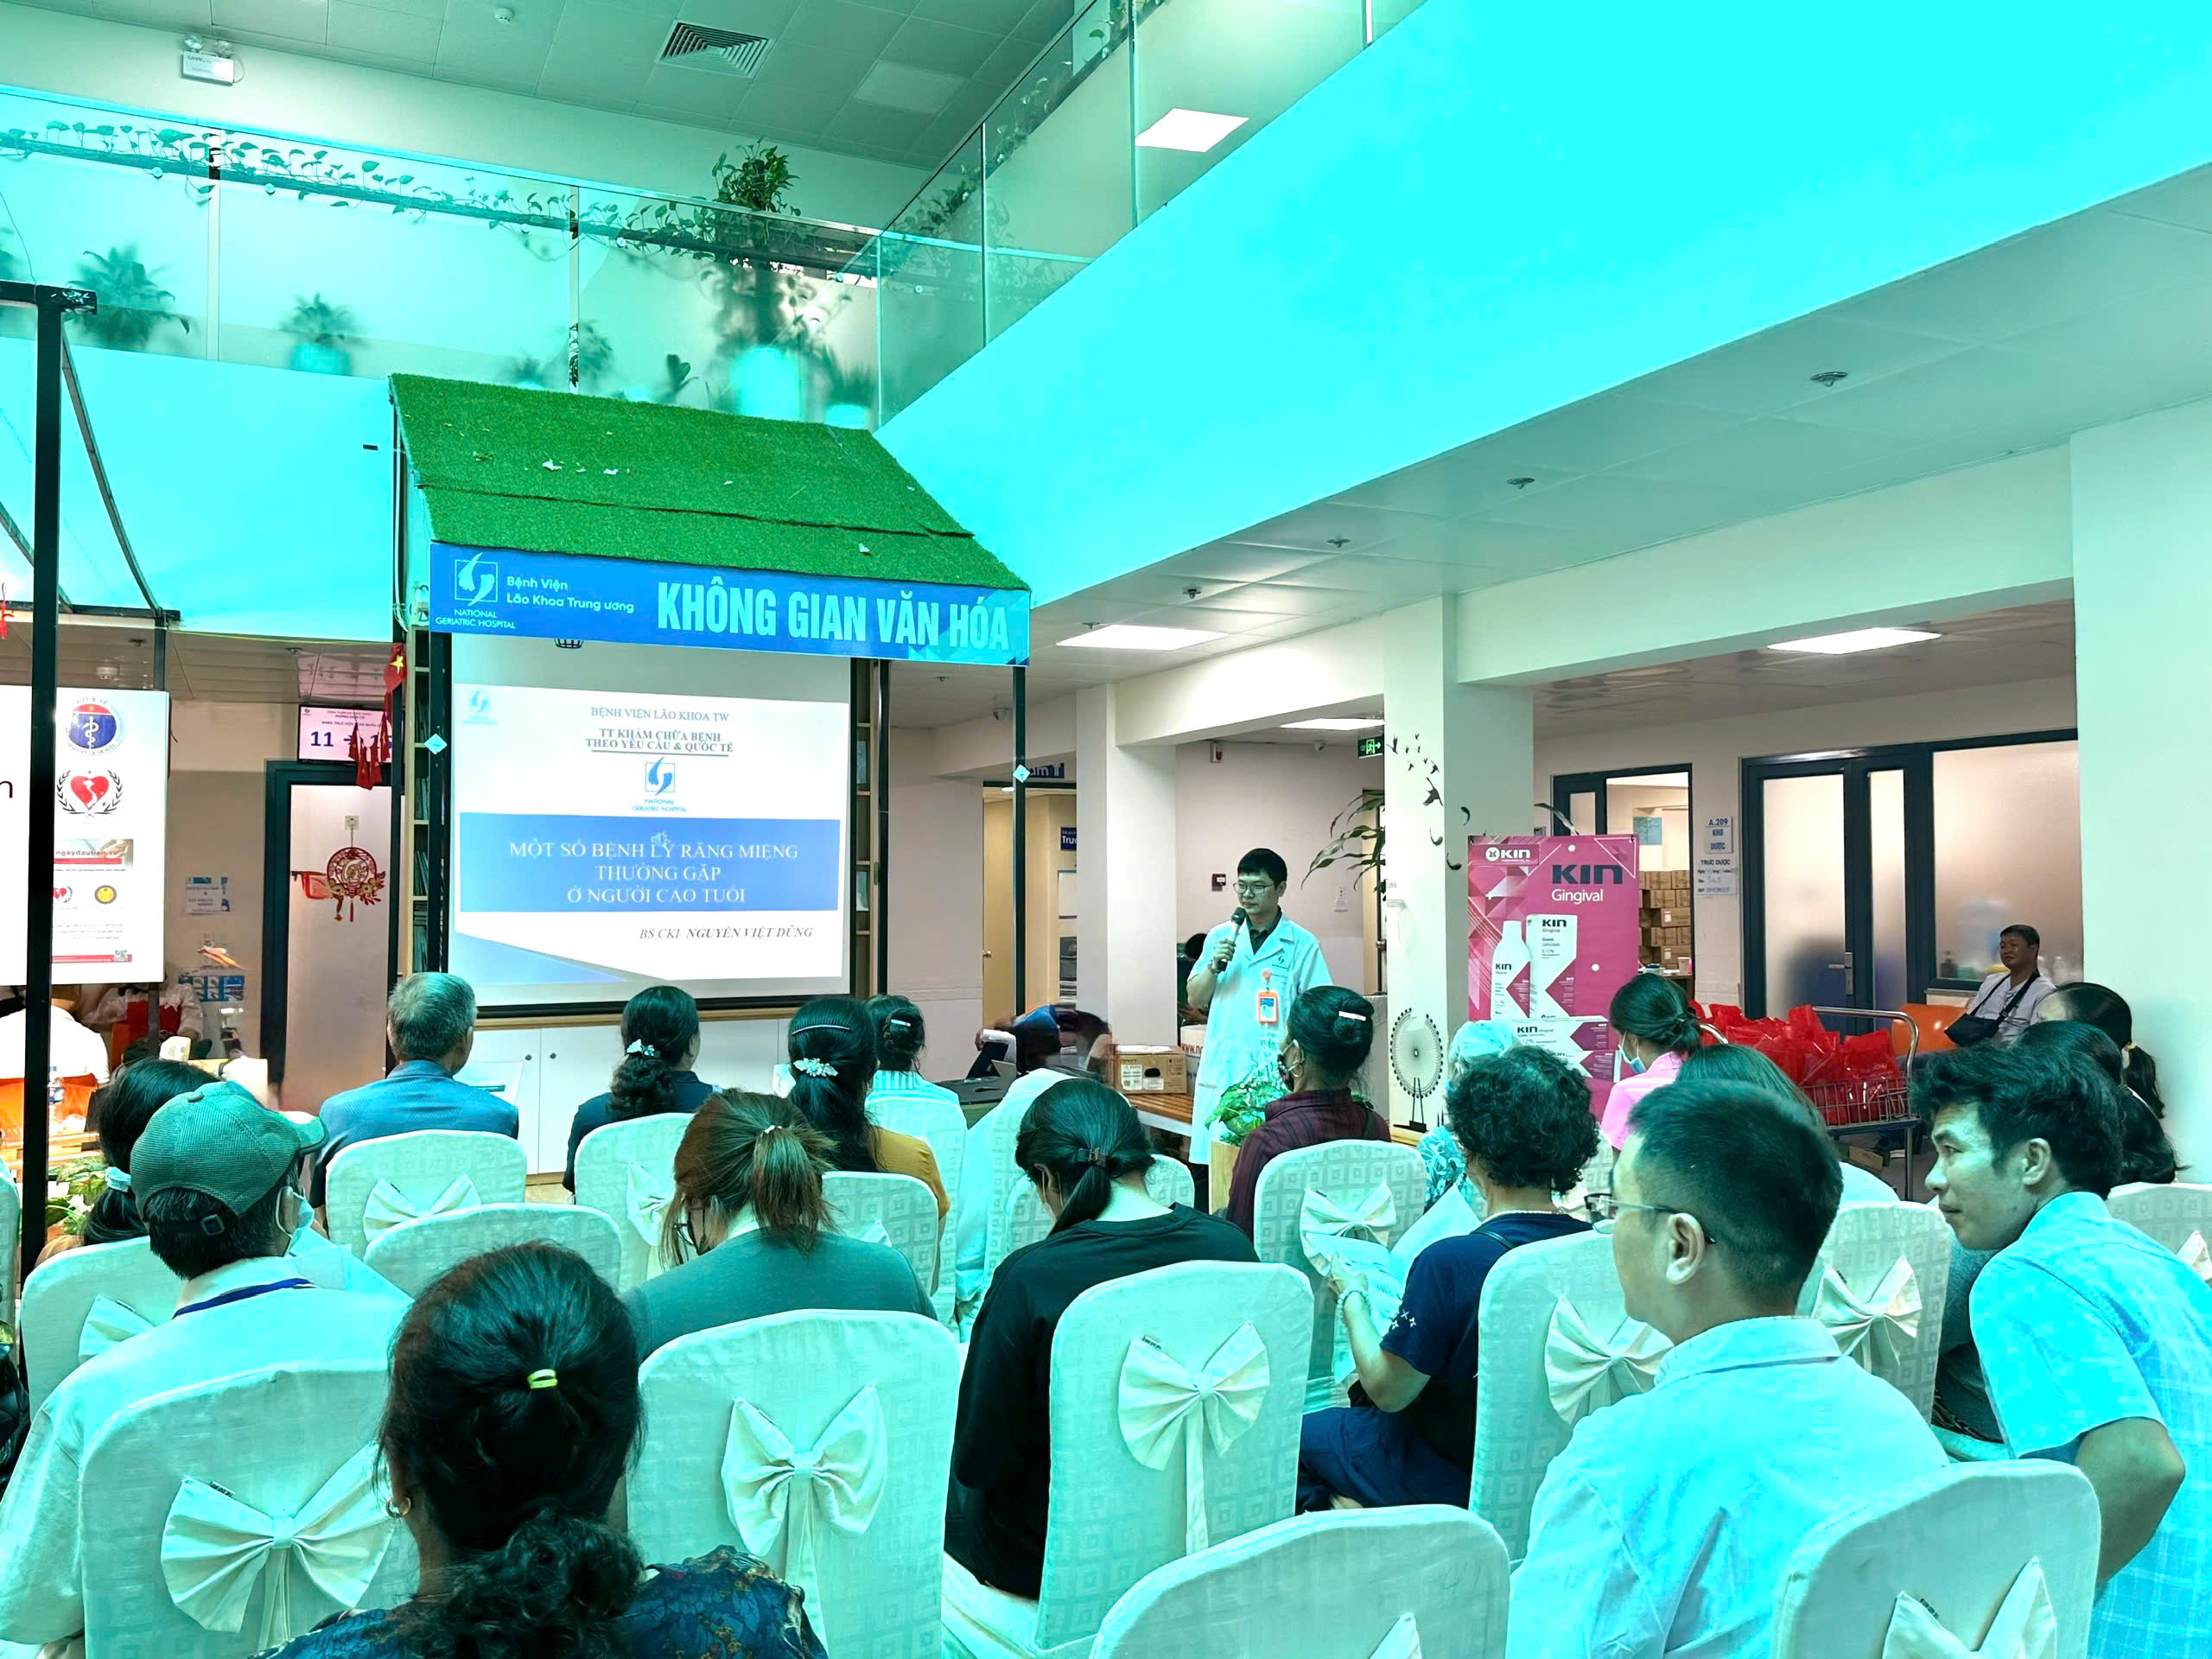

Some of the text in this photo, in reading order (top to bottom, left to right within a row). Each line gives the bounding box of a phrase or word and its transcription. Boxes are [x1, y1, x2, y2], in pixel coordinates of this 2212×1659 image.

[506, 576, 569, 593] Bệnh Viện
[506, 593, 634, 614] Lão Khoa Trung ương
[454, 609, 498, 620] NATIONAL
[658, 575, 1010, 651] KHÔNG GIAN VĂN HÓA
[435, 617, 516, 629] GERIATRIC HOSPITAL
[679, 711, 710, 721] KHOA
[713, 713, 729, 721] TW
[311, 731, 334, 747] 11
[599, 728, 615, 738] TT
[586, 738, 619, 748] THEO
[656, 888, 697, 904] CAO
[1551, 889, 1604, 905] Gingival
[640, 928, 655, 939] BS
